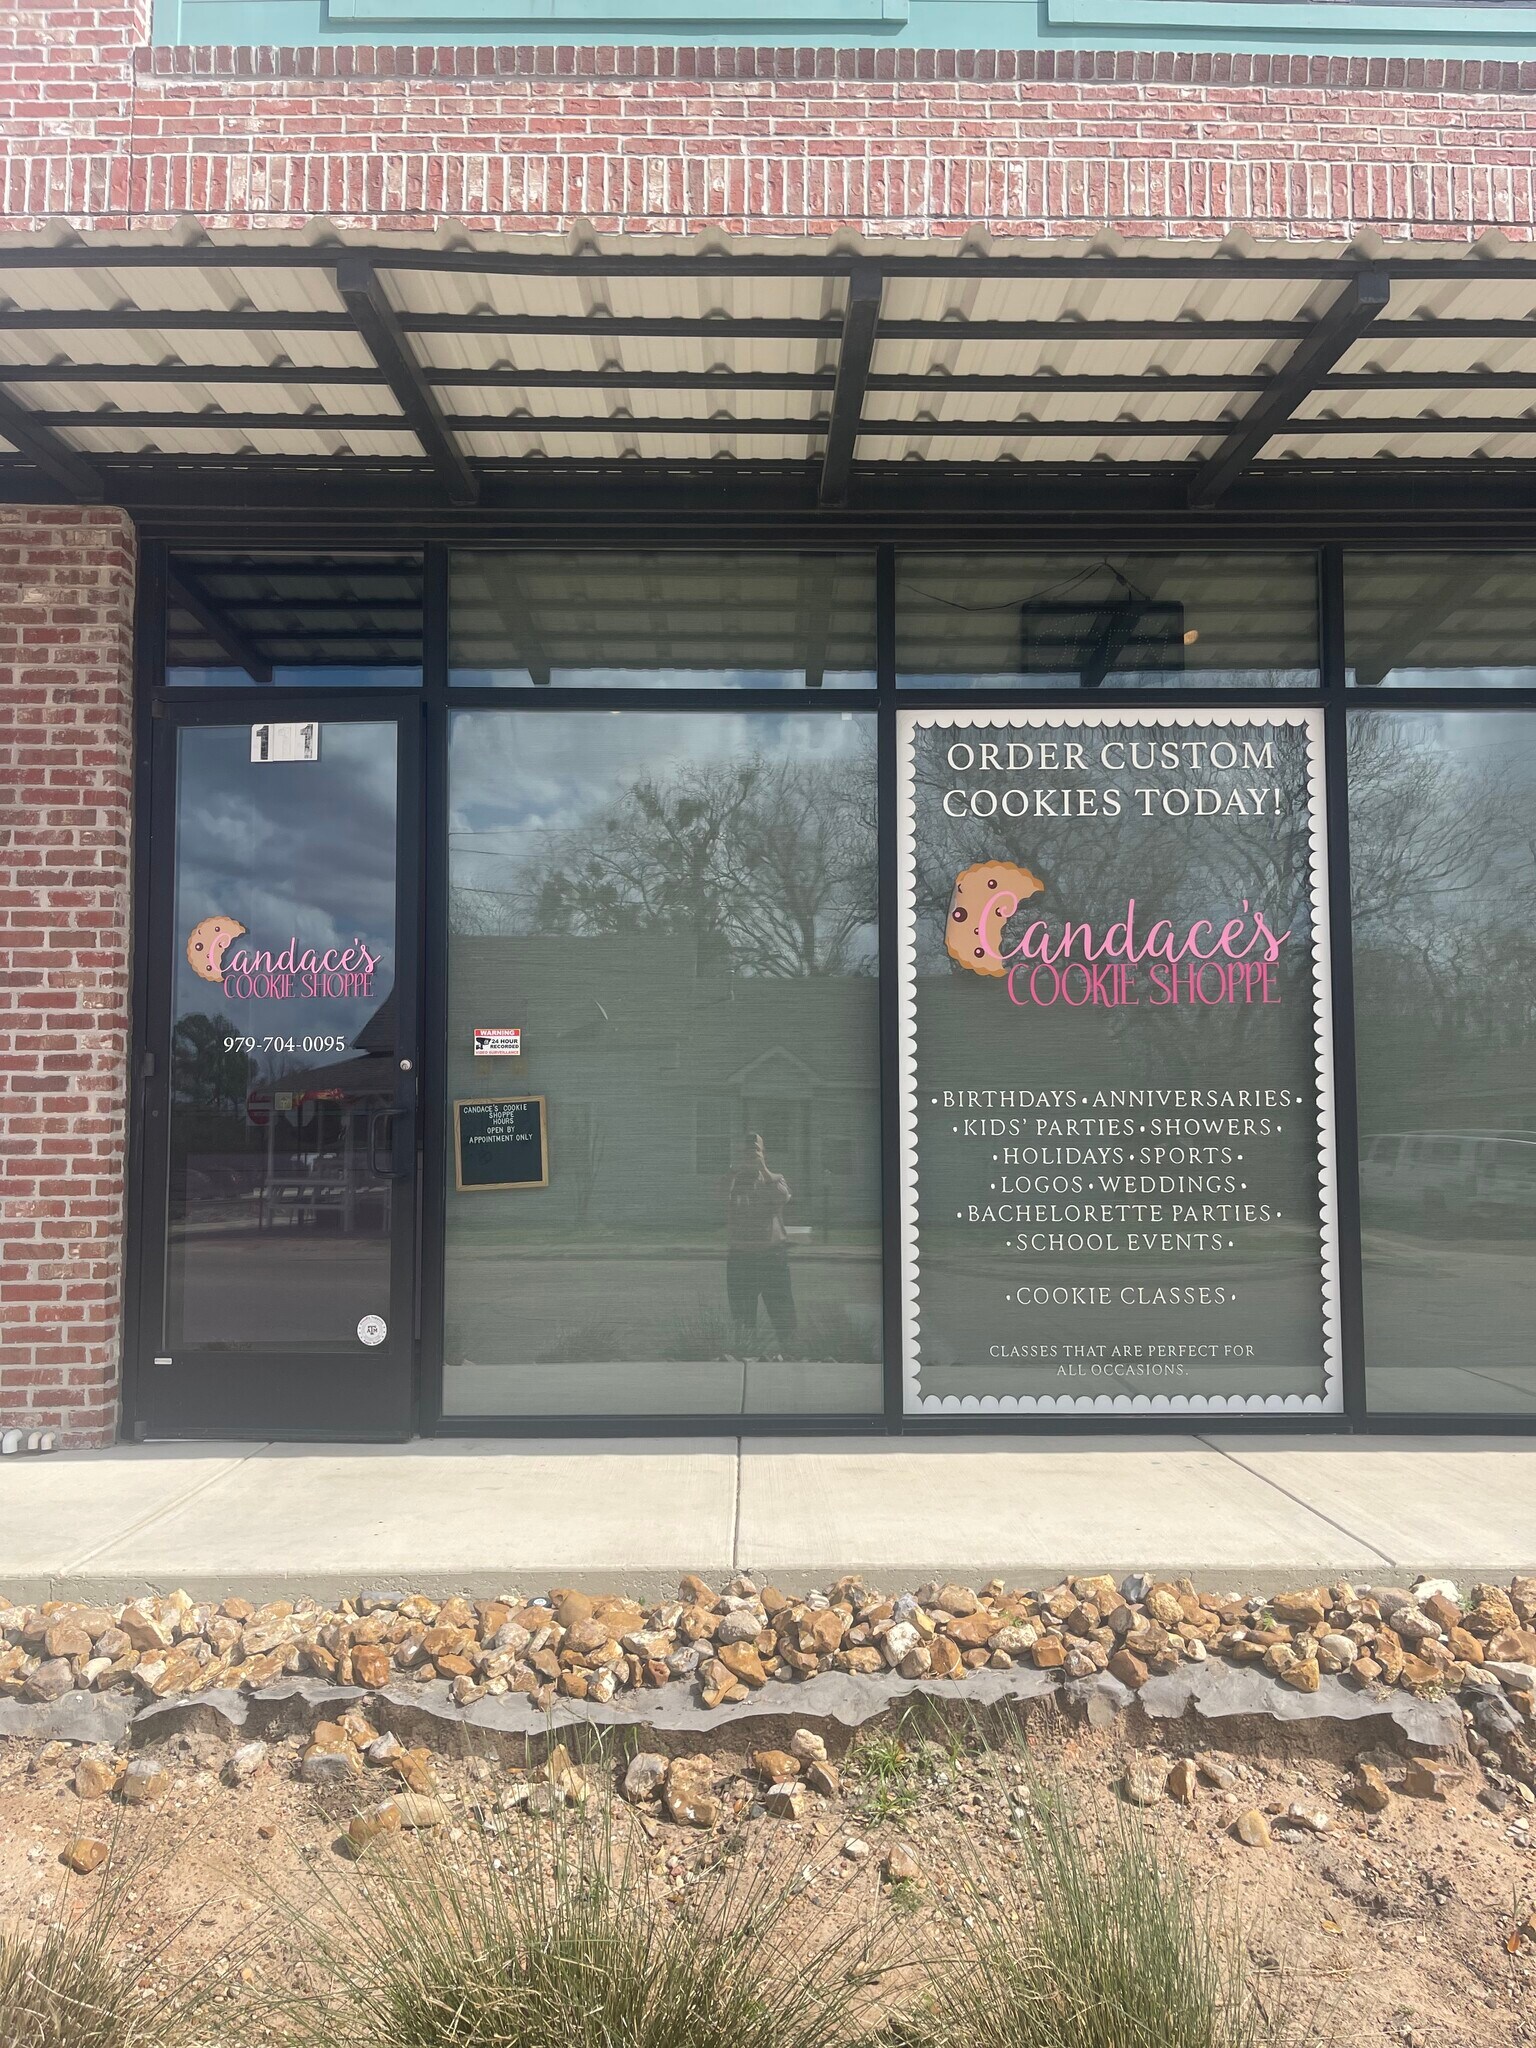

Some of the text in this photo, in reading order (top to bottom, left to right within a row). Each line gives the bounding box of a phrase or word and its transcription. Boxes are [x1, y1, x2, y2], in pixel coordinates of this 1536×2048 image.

[947, 741, 1276, 771] ORDER CUSTOM
[942, 787, 1283, 817] COOKIES TODAY!
[978, 890, 1291, 964] Candace's
[208, 932, 381, 975] Candace's
[223, 972, 375, 999] COOKIE SHOPPE
[1007, 961, 1282, 1008] COOKIE SHOPPE
[223, 1035, 346, 1053] 979-704-0095
[943, 1090, 1291, 1108] BIRTHDAYS ANNIVERSARIES
[463, 1104, 499, 1114] CANDACE'S
[486, 1125, 515, 1134] OPEN BY
[493, 1117, 514, 1125] HOURS
[963, 1118, 1271, 1136] KIDS' PARTIES SHOWERS
[469, 1133, 533, 1144] APPOINTMENT ONLY
[1003, 1147, 1232, 1165] HOLIDAYS SPORTS
[1001, 1175, 1236, 1194] LOGOS WEDDINGS
[967, 1204, 1271, 1223] BACHELORETTE PARTIES
[1016, 1233, 1223, 1251] SCHOOL EVENTS
[1016, 1286, 1225, 1305] COOKIE CLASSES
[989, 1344, 1255, 1358] CLASSES THAT ARE PERFECT FOR
[1056, 1363, 1189, 1376] ALL OCCASIONS.
